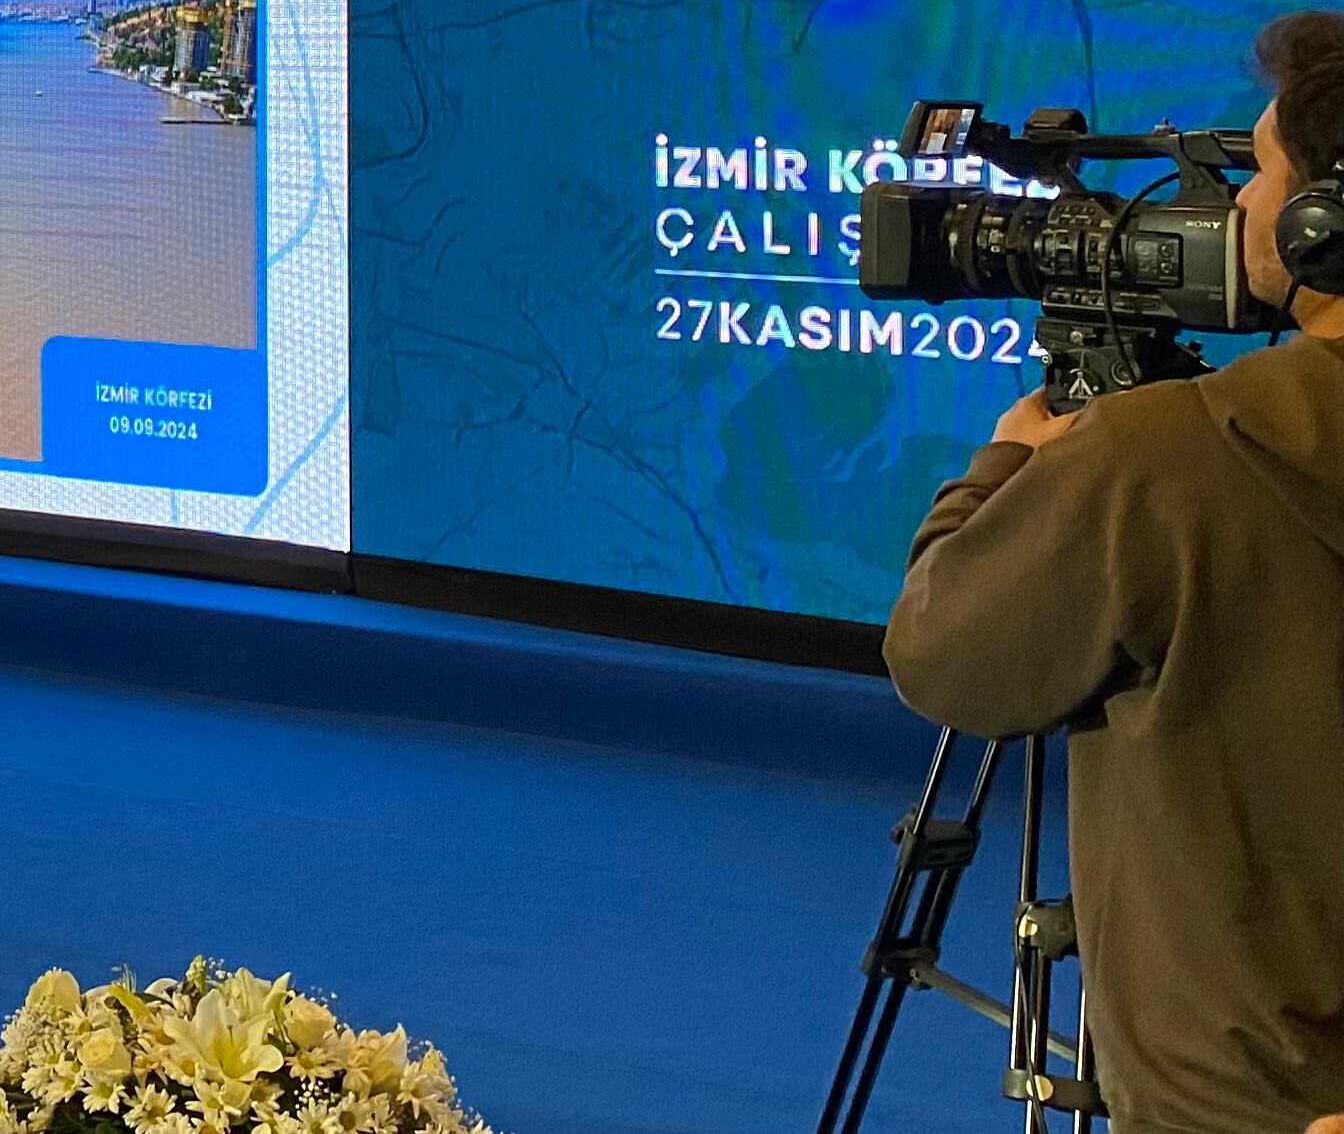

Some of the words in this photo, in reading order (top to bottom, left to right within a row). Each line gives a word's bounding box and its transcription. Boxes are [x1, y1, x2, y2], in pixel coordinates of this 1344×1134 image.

[654, 132, 809, 193] İZMİR
[1184, 220, 1222, 230] SONY
[95, 379, 140, 405] İZMİR
[144, 385, 213, 411] KÖRFEZİ
